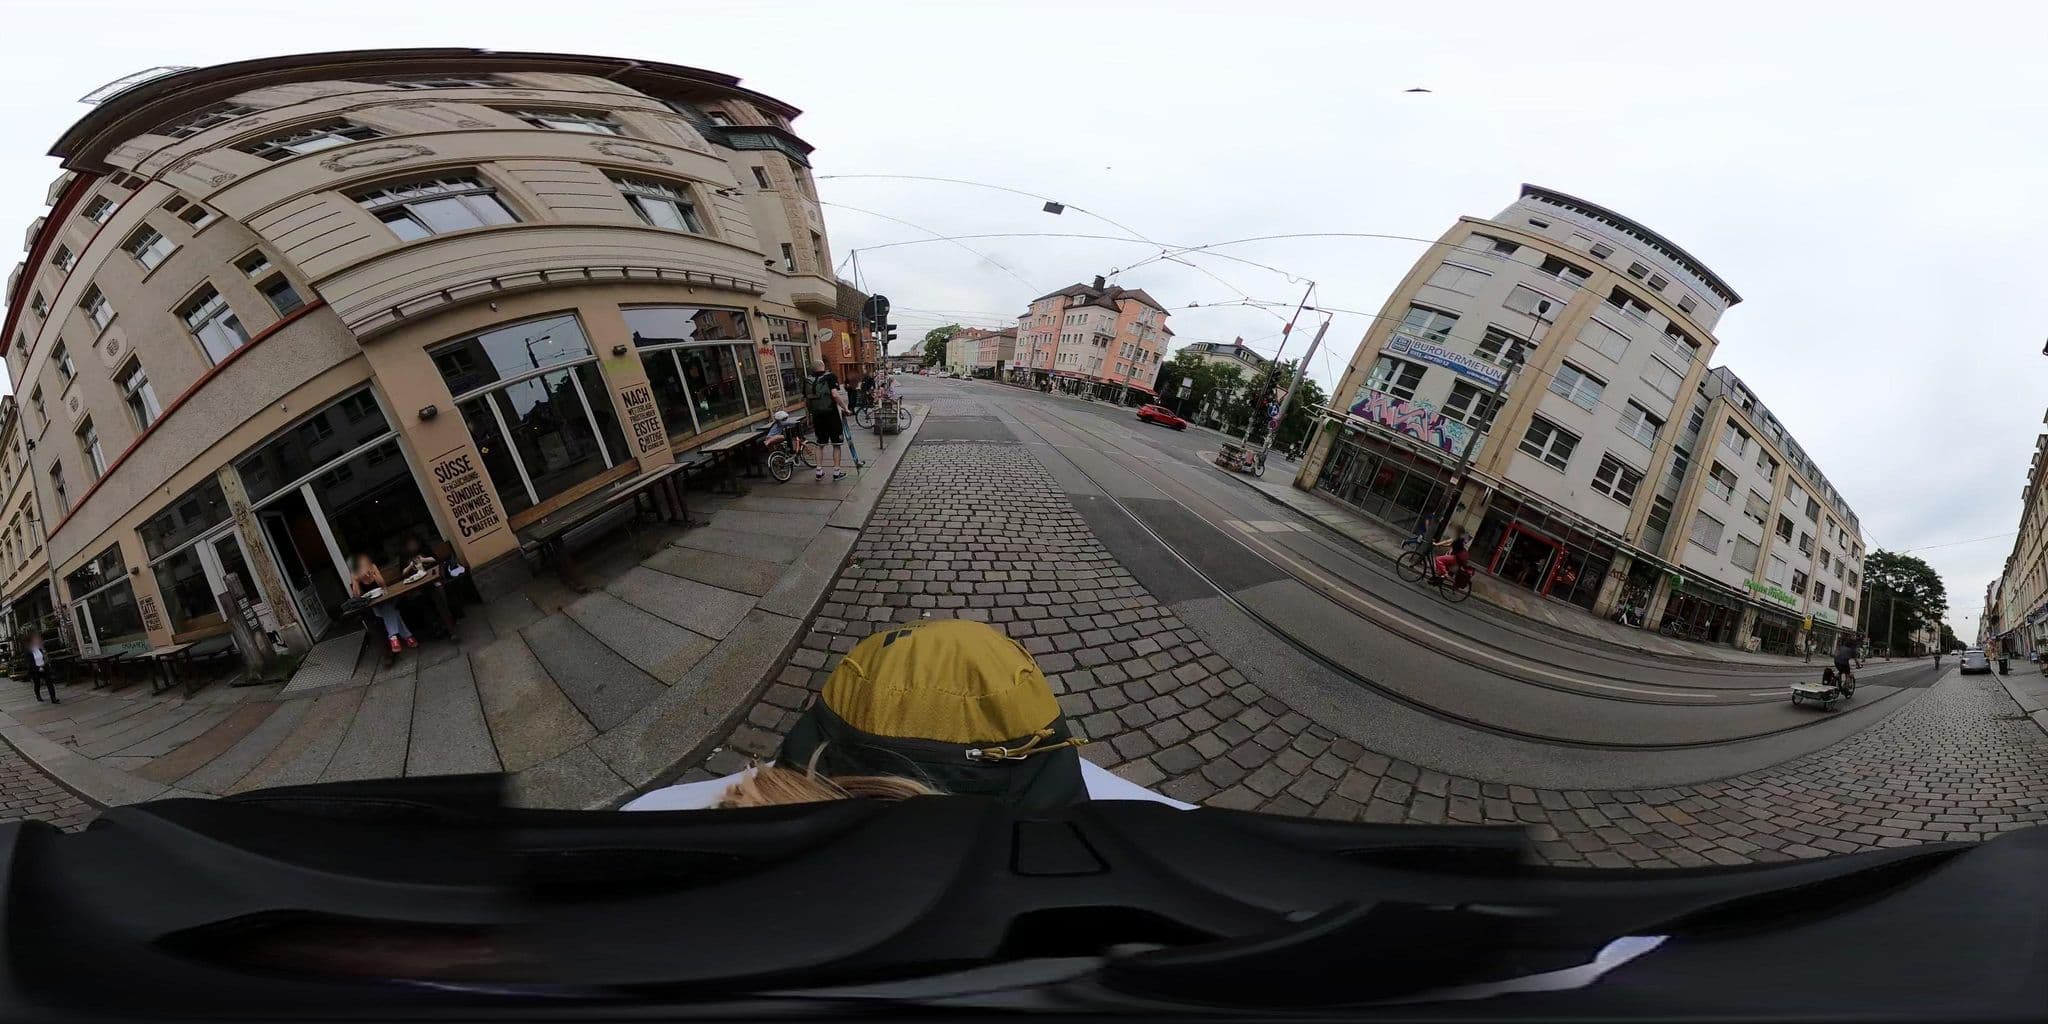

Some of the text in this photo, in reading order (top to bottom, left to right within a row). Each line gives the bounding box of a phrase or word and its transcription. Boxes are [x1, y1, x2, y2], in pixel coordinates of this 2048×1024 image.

[621, 386, 651, 408] NACH
[633, 416, 660, 437] EISTEE
[638, 437, 647, 453] &
[434, 454, 474, 483] SÜSSE
[446, 481, 486, 507] SÜNDIGE
[452, 493, 491, 519] BROWNIES
[458, 503, 495, 537] & WILLIGE
[471, 514, 500, 533] WAFFELN
